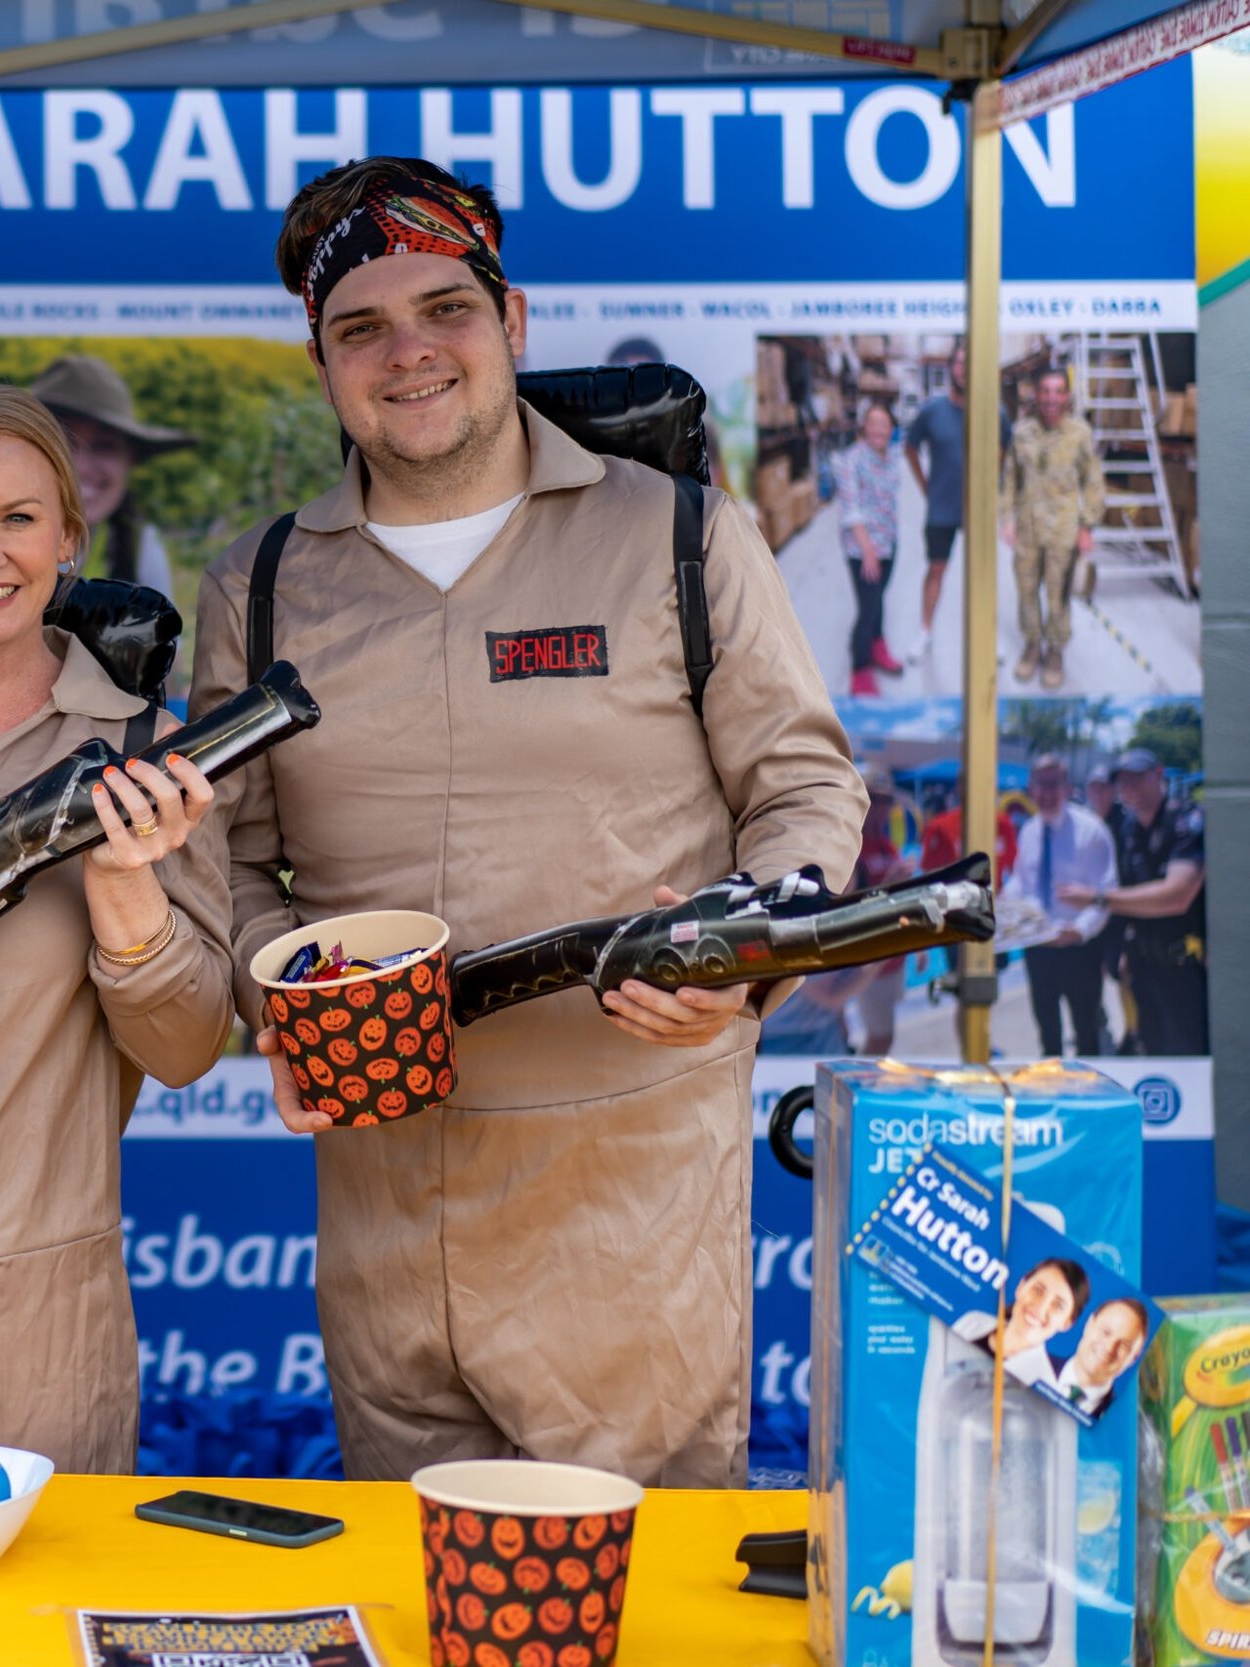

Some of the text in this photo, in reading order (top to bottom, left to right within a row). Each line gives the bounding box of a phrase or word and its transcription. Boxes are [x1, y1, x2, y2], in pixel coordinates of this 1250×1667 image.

[420, 86, 1076, 210] HUTTON
[789, 299, 898, 319] JAMBOREE
[1008, 297, 1073, 318] OXLEY
[1091, 296, 1162, 317] DARRA
[494, 633, 601, 675] SPENGLER
[868, 1112, 1064, 1147] sodastream
[916, 1167, 941, 1192] Cr
[937, 1181, 991, 1231] Sarah
[121, 1213, 318, 1290] isban
[890, 1184, 1010, 1291] Hutton
[138, 1329, 257, 1395] the
